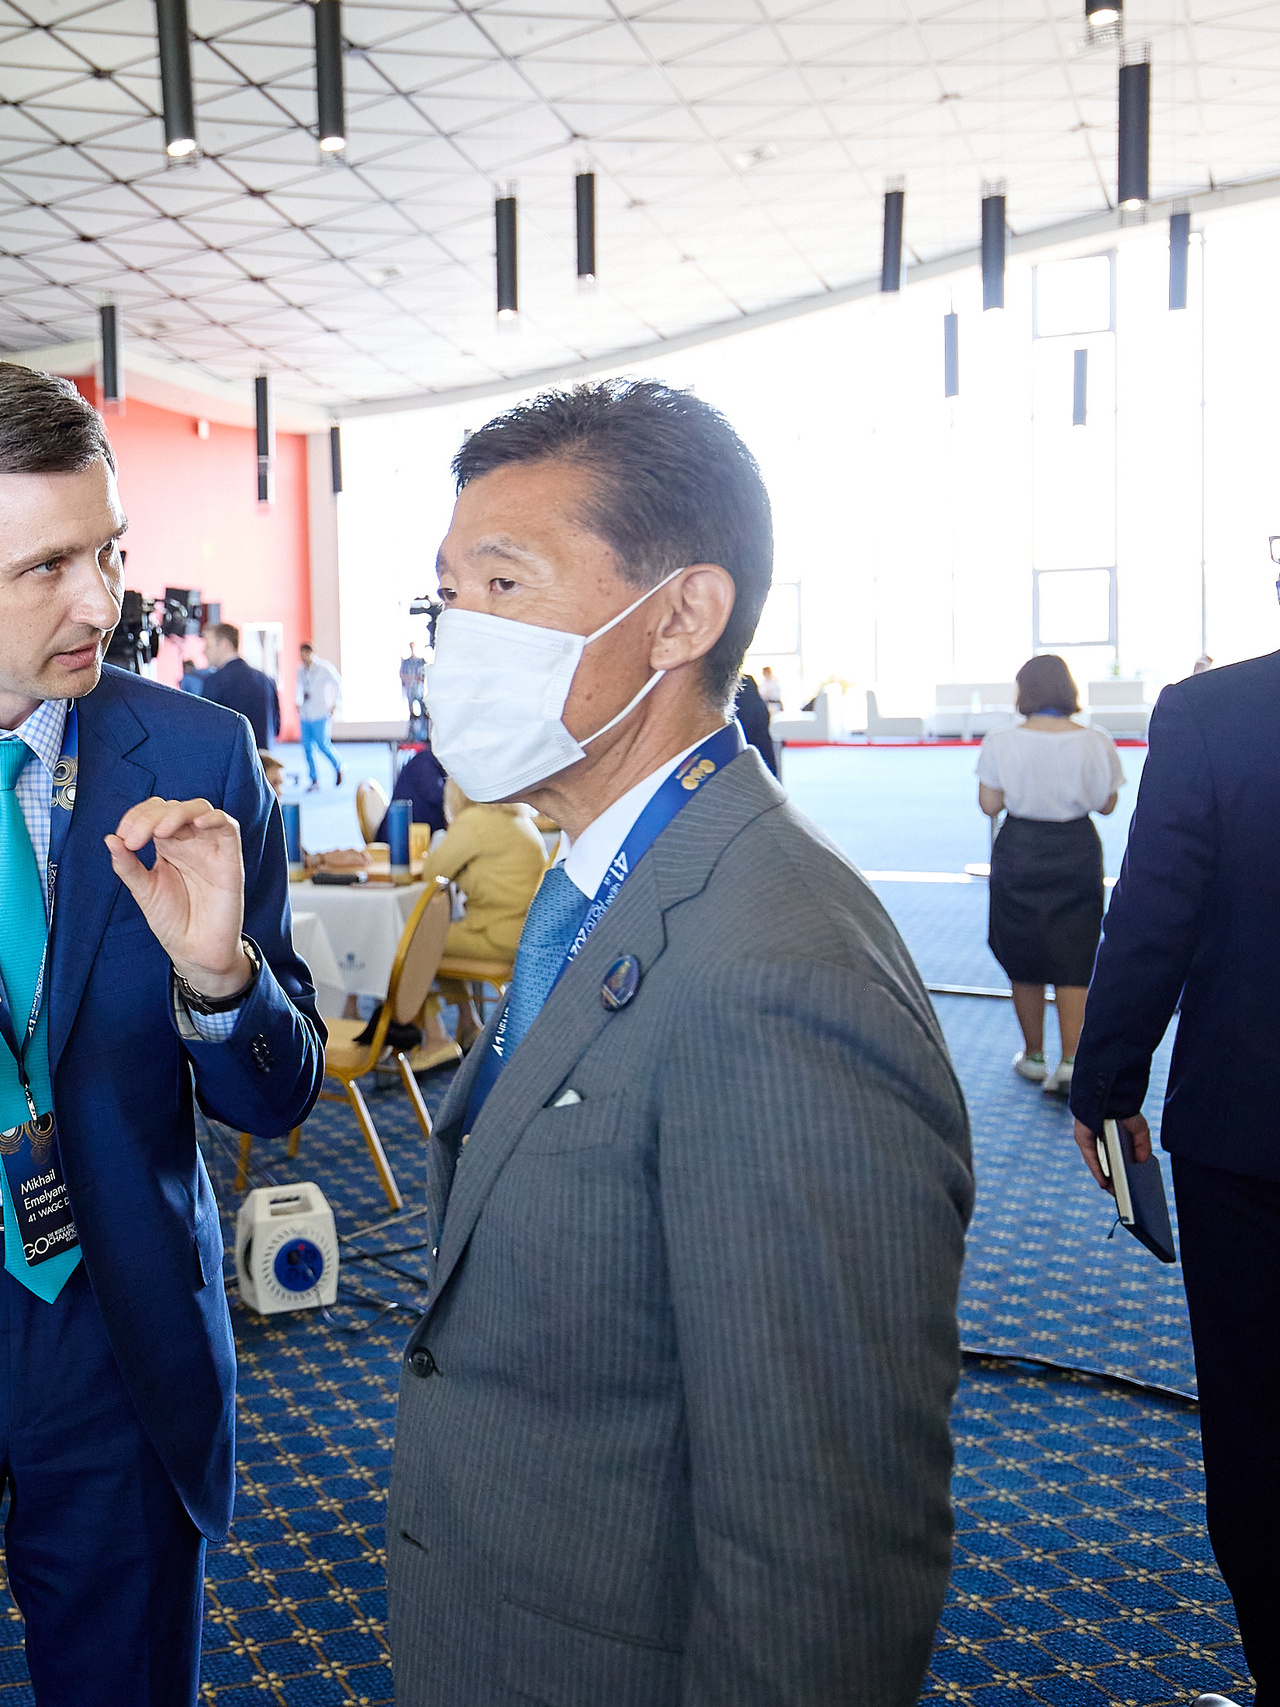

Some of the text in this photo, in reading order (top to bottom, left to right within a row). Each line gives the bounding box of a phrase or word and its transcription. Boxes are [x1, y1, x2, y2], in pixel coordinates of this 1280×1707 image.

[20, 1168, 56, 1195] Mikhail
[28, 1213, 37, 1223] 41
[38, 1200, 64, 1218] WAGC
[23, 1237, 49, 1261] GO
